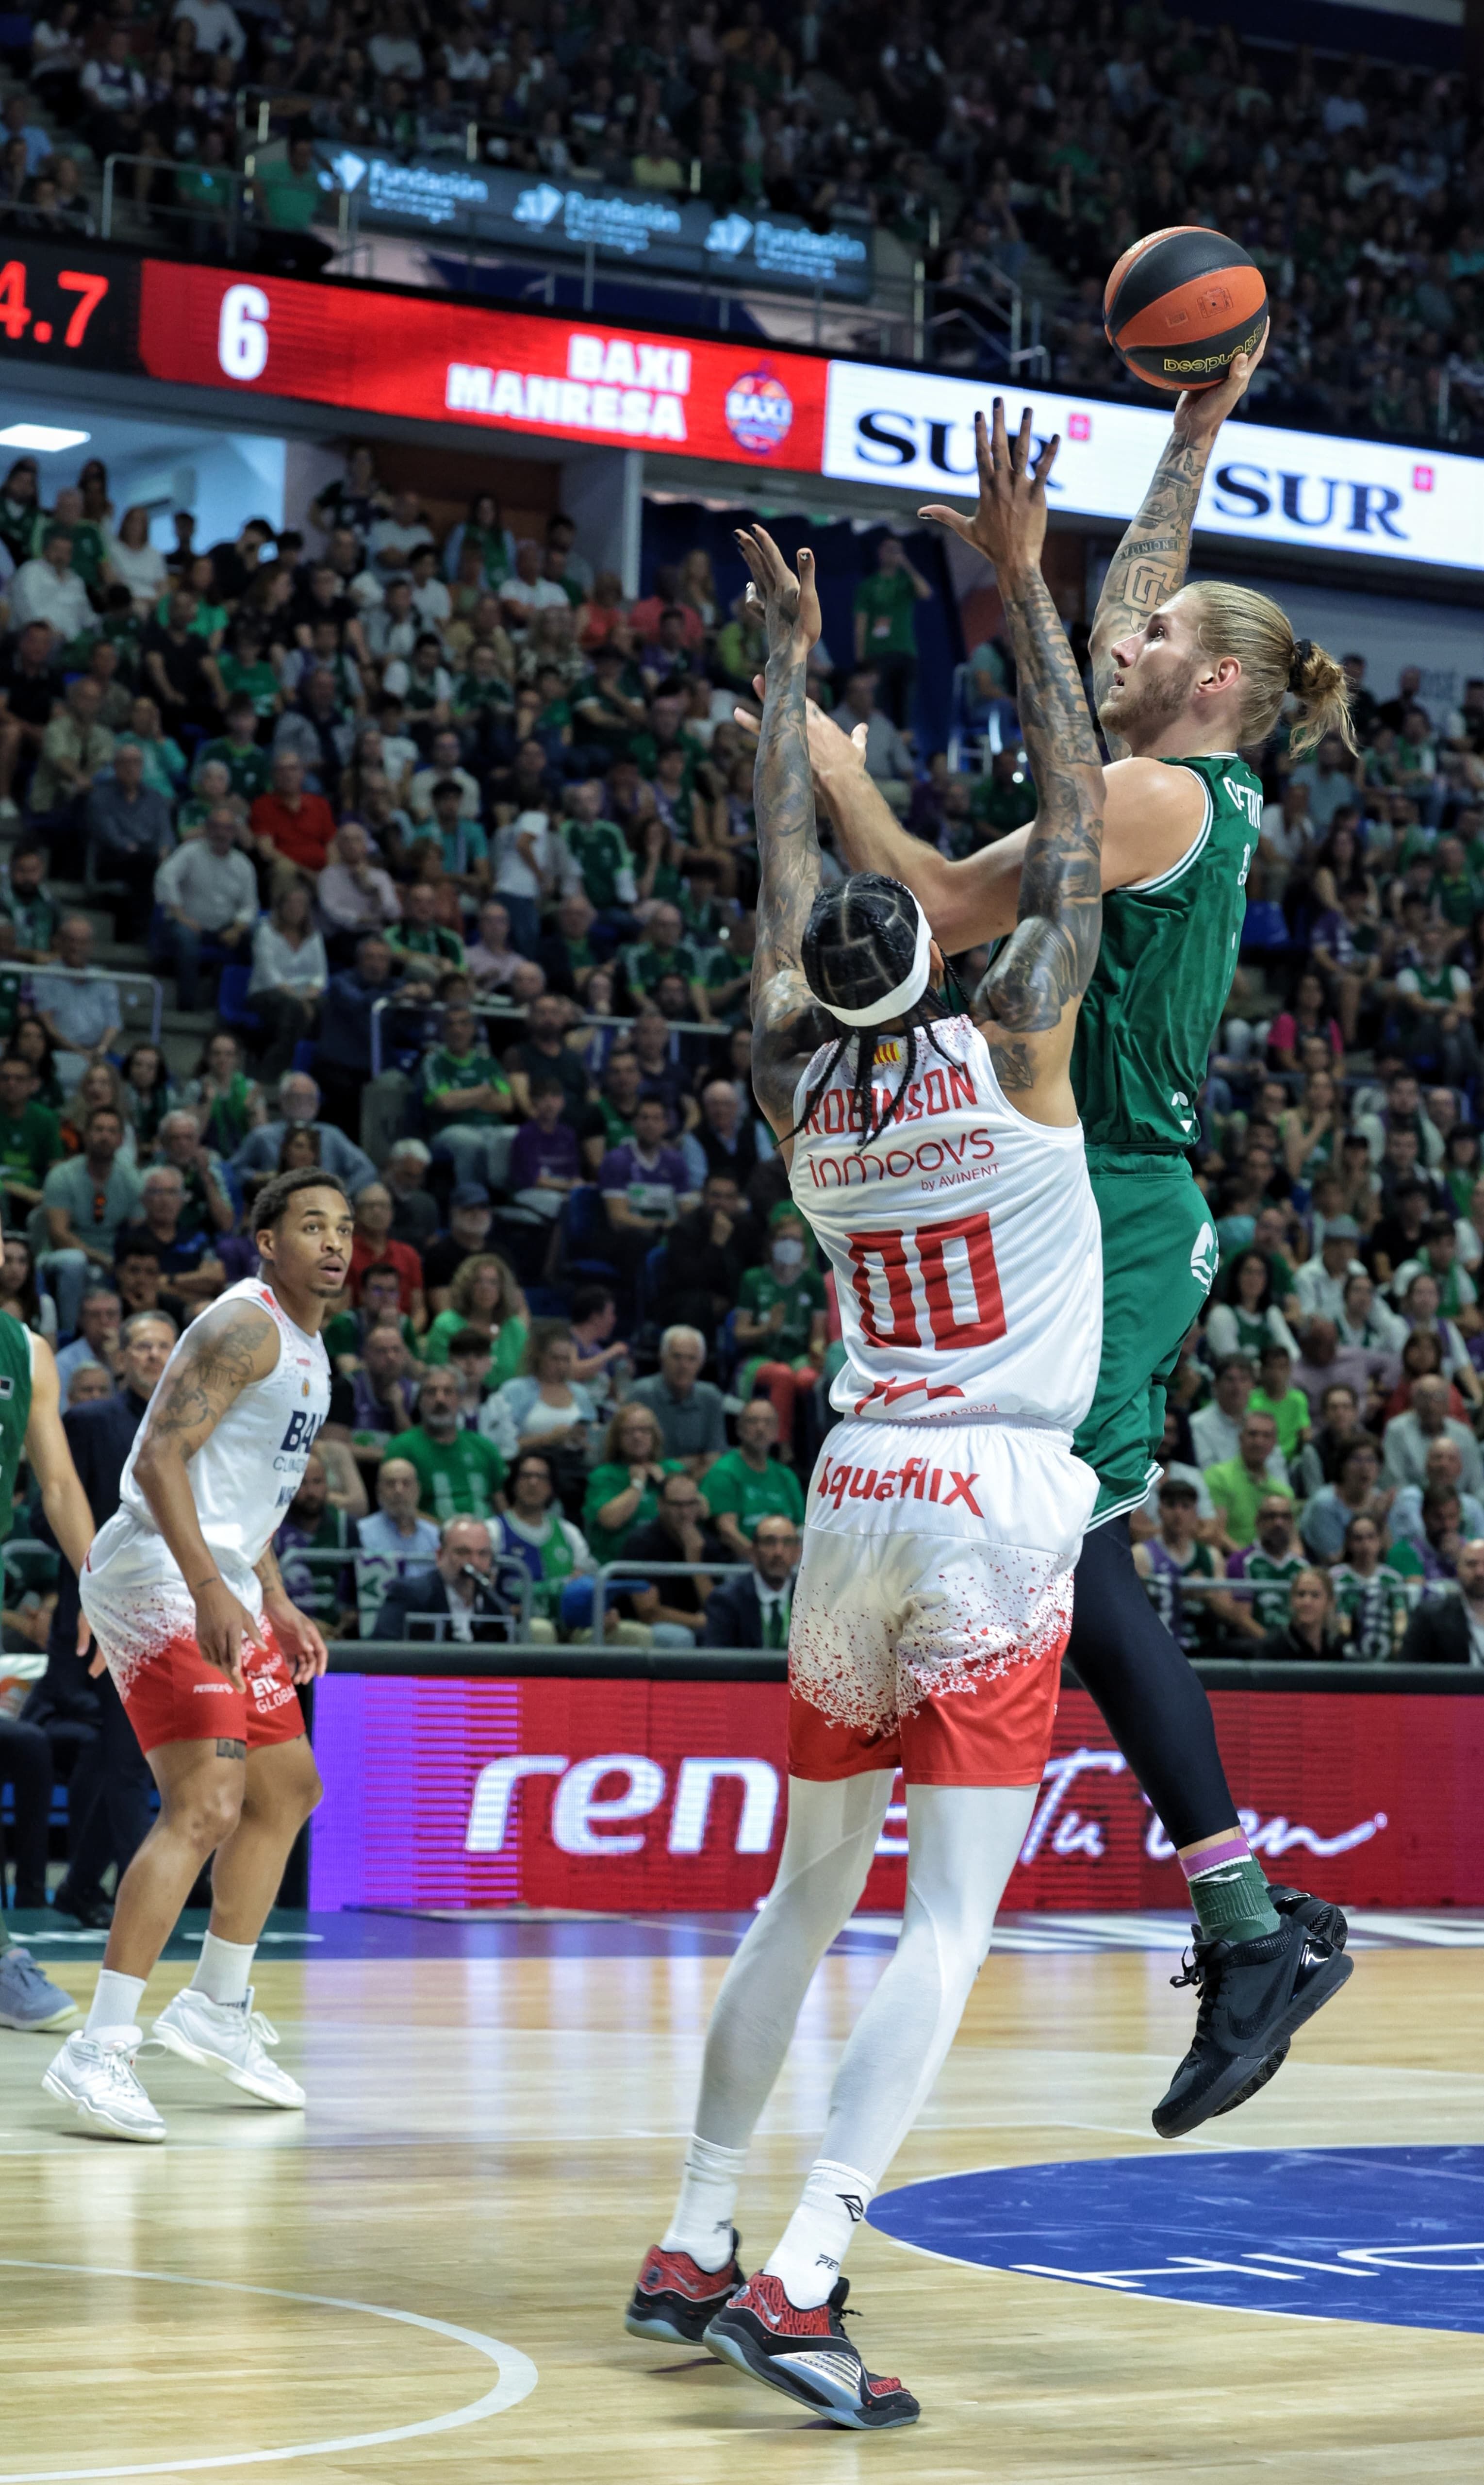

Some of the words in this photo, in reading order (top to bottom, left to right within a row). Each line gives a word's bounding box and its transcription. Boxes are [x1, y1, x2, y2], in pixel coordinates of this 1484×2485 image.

[218, 284, 270, 381] 6
[568, 334, 691, 396] BAXI
[446, 363, 687, 442] MANRESA
[727, 390, 793, 426] BAXI
[856, 410, 1064, 490] SUR
[1212, 464, 1408, 540] SUR
[804, 1062, 978, 1135] ROBINSON
[807, 1129, 994, 1187] inmoovs
[922, 1179, 935, 1192] by
[939, 1163, 999, 1189] AVINENT
[845, 1212, 1007, 1351] 00
[1020, 1747, 1127, 1864] Tu
